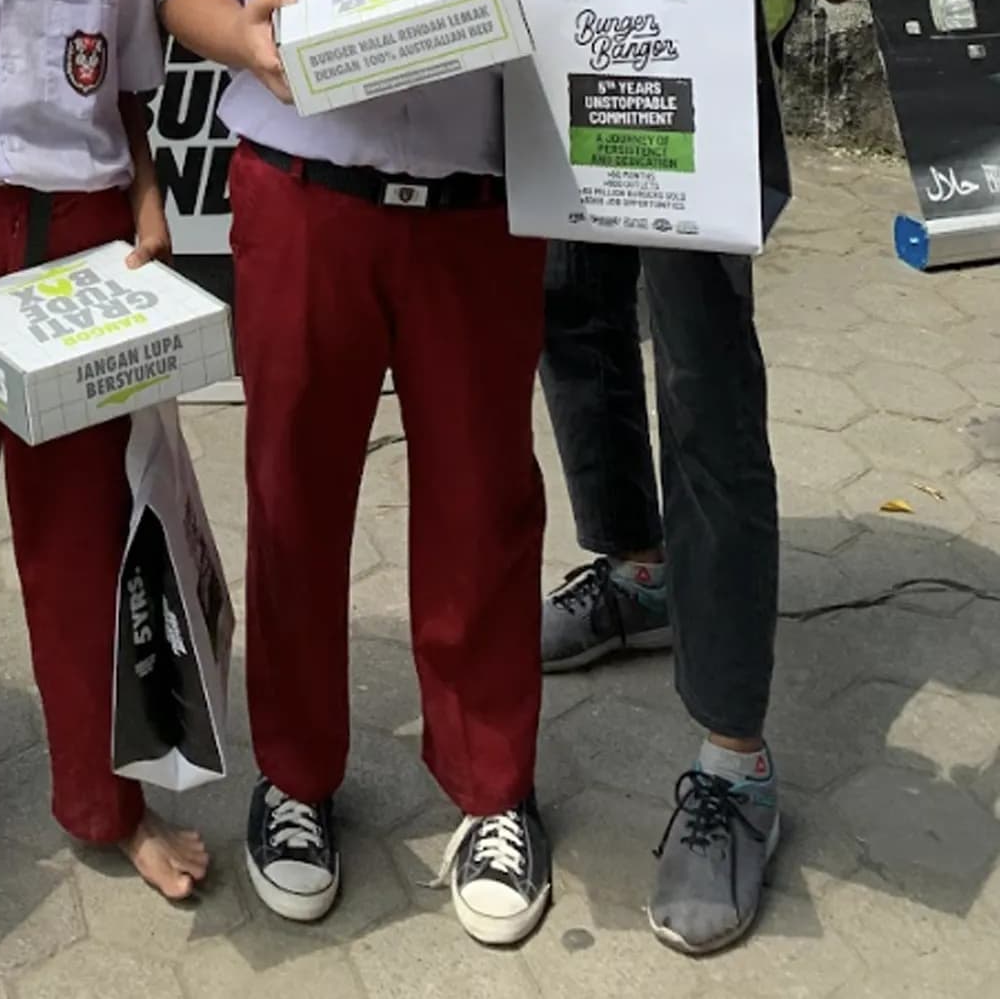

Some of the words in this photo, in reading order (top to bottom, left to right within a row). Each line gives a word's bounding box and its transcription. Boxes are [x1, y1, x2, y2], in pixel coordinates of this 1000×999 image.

[309, 43, 358, 67] BURGER
[397, 20, 446, 42] RENDAH
[447, 5, 491, 28] LEMAK
[574, 8, 662, 47] Burger
[314, 58, 362, 83] DENGAN
[363, 49, 397, 69] 100%
[399, 29, 468, 62] AUSTRALIAN
[468, 20, 494, 40] BEEF
[589, 35, 680, 72] Bangor
[584, 95, 678, 111] UNSTOPPABLE
[618, 81, 662, 96] YEARS
[588, 111, 675, 126] COMMITMENT
[926, 165, 980, 202] حلال
[76, 345, 140, 384] JANGAN
[142, 334, 184, 362] LUPA
[85, 355, 178, 400] BERSYUKUR
